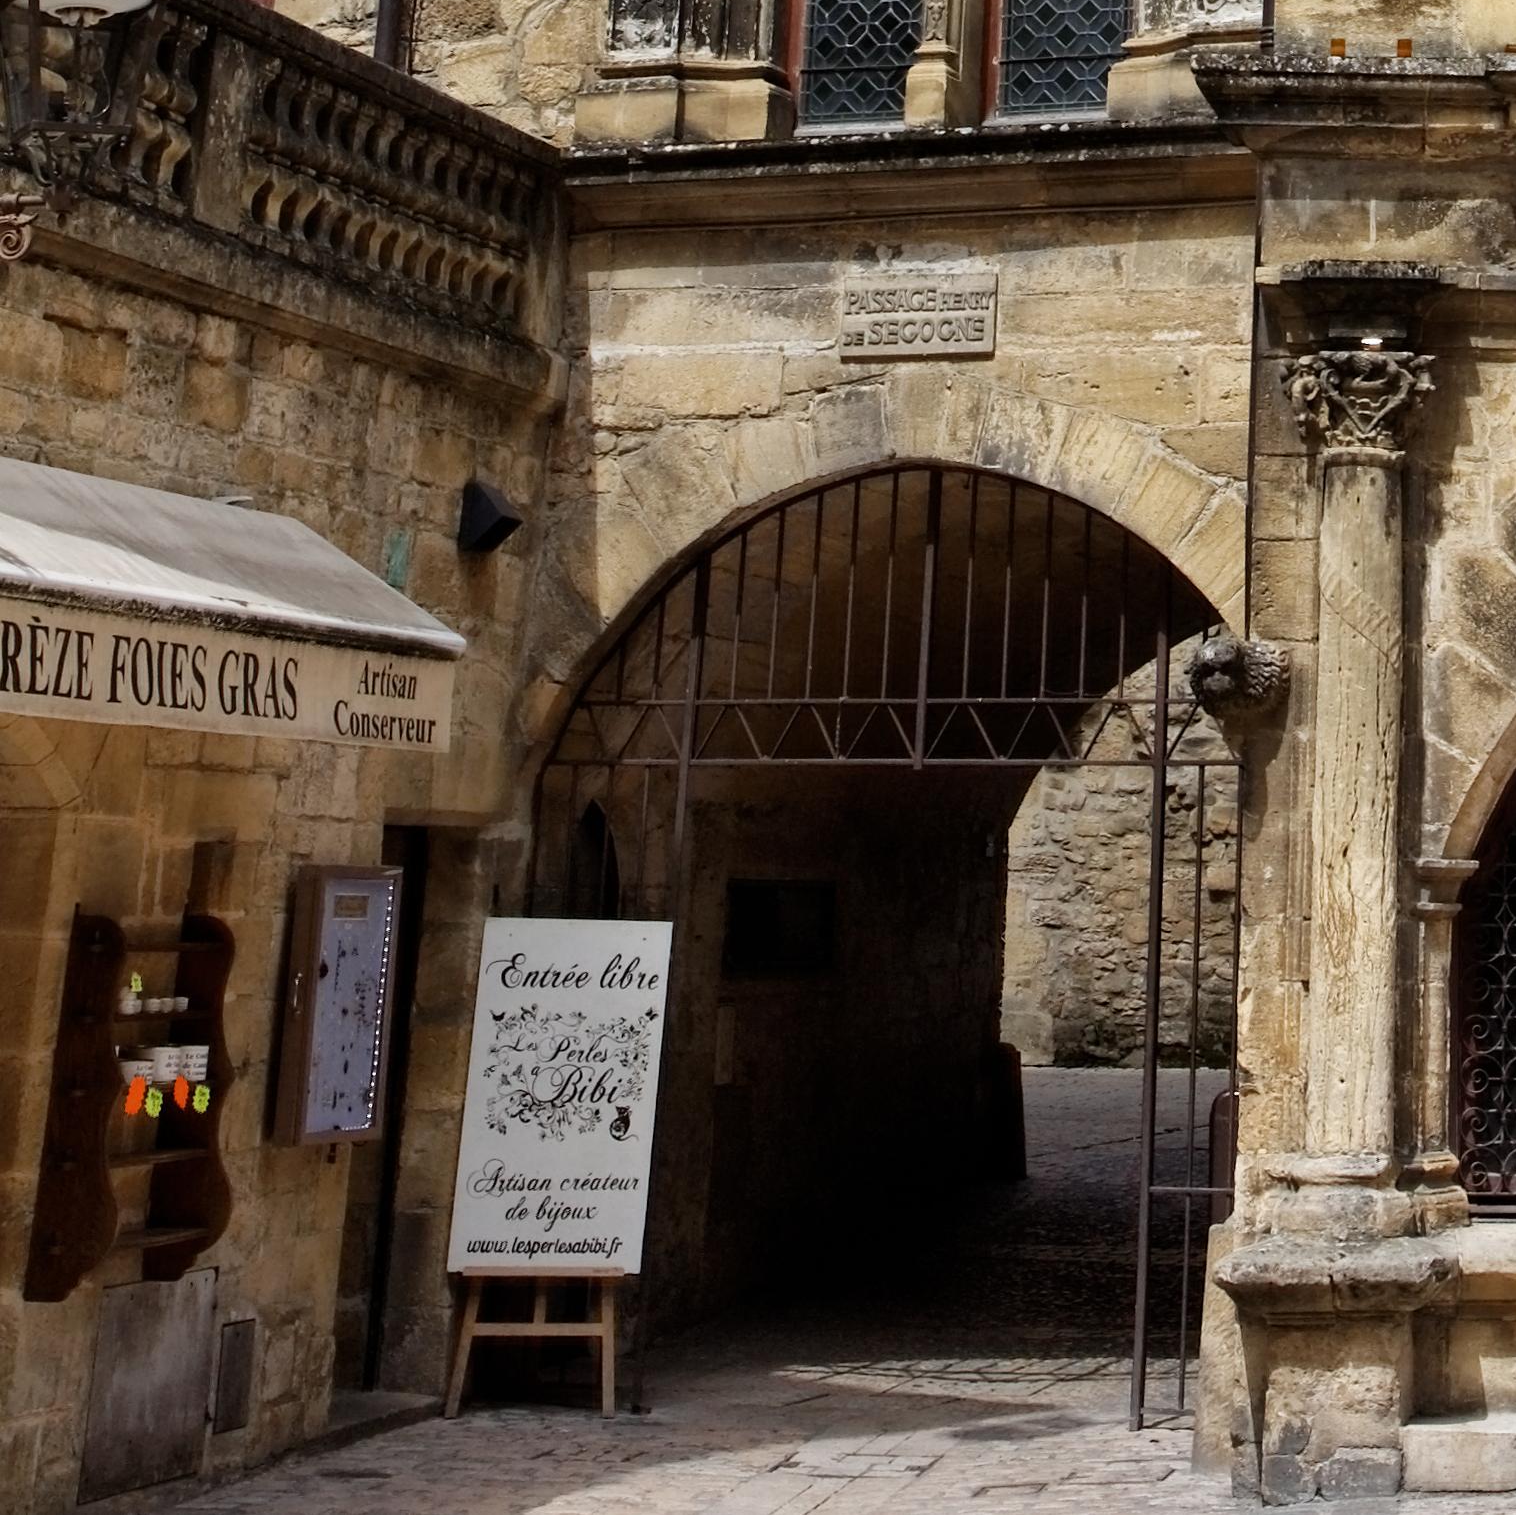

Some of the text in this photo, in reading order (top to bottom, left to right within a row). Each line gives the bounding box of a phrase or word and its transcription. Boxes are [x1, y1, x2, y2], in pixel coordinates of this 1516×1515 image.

[844, 288, 937, 315] PASSAGE
[842, 330, 865, 346] DE
[106, 634, 207, 716] FOIES
[217, 649, 299, 722] GRAS
[357, 659, 417, 700] Artisan
[334, 699, 436, 744] Conserveur
[486, 953, 660, 990] Entrée libre
[536, 1034, 608, 1063] Perles
[532, 1064, 622, 1104] Bibi
[467, 1159, 640, 1199] Artisan créateur
[505, 1196, 598, 1232] de bijoux
[467, 1237, 623, 1260] www.lesperlesabibi.fr
